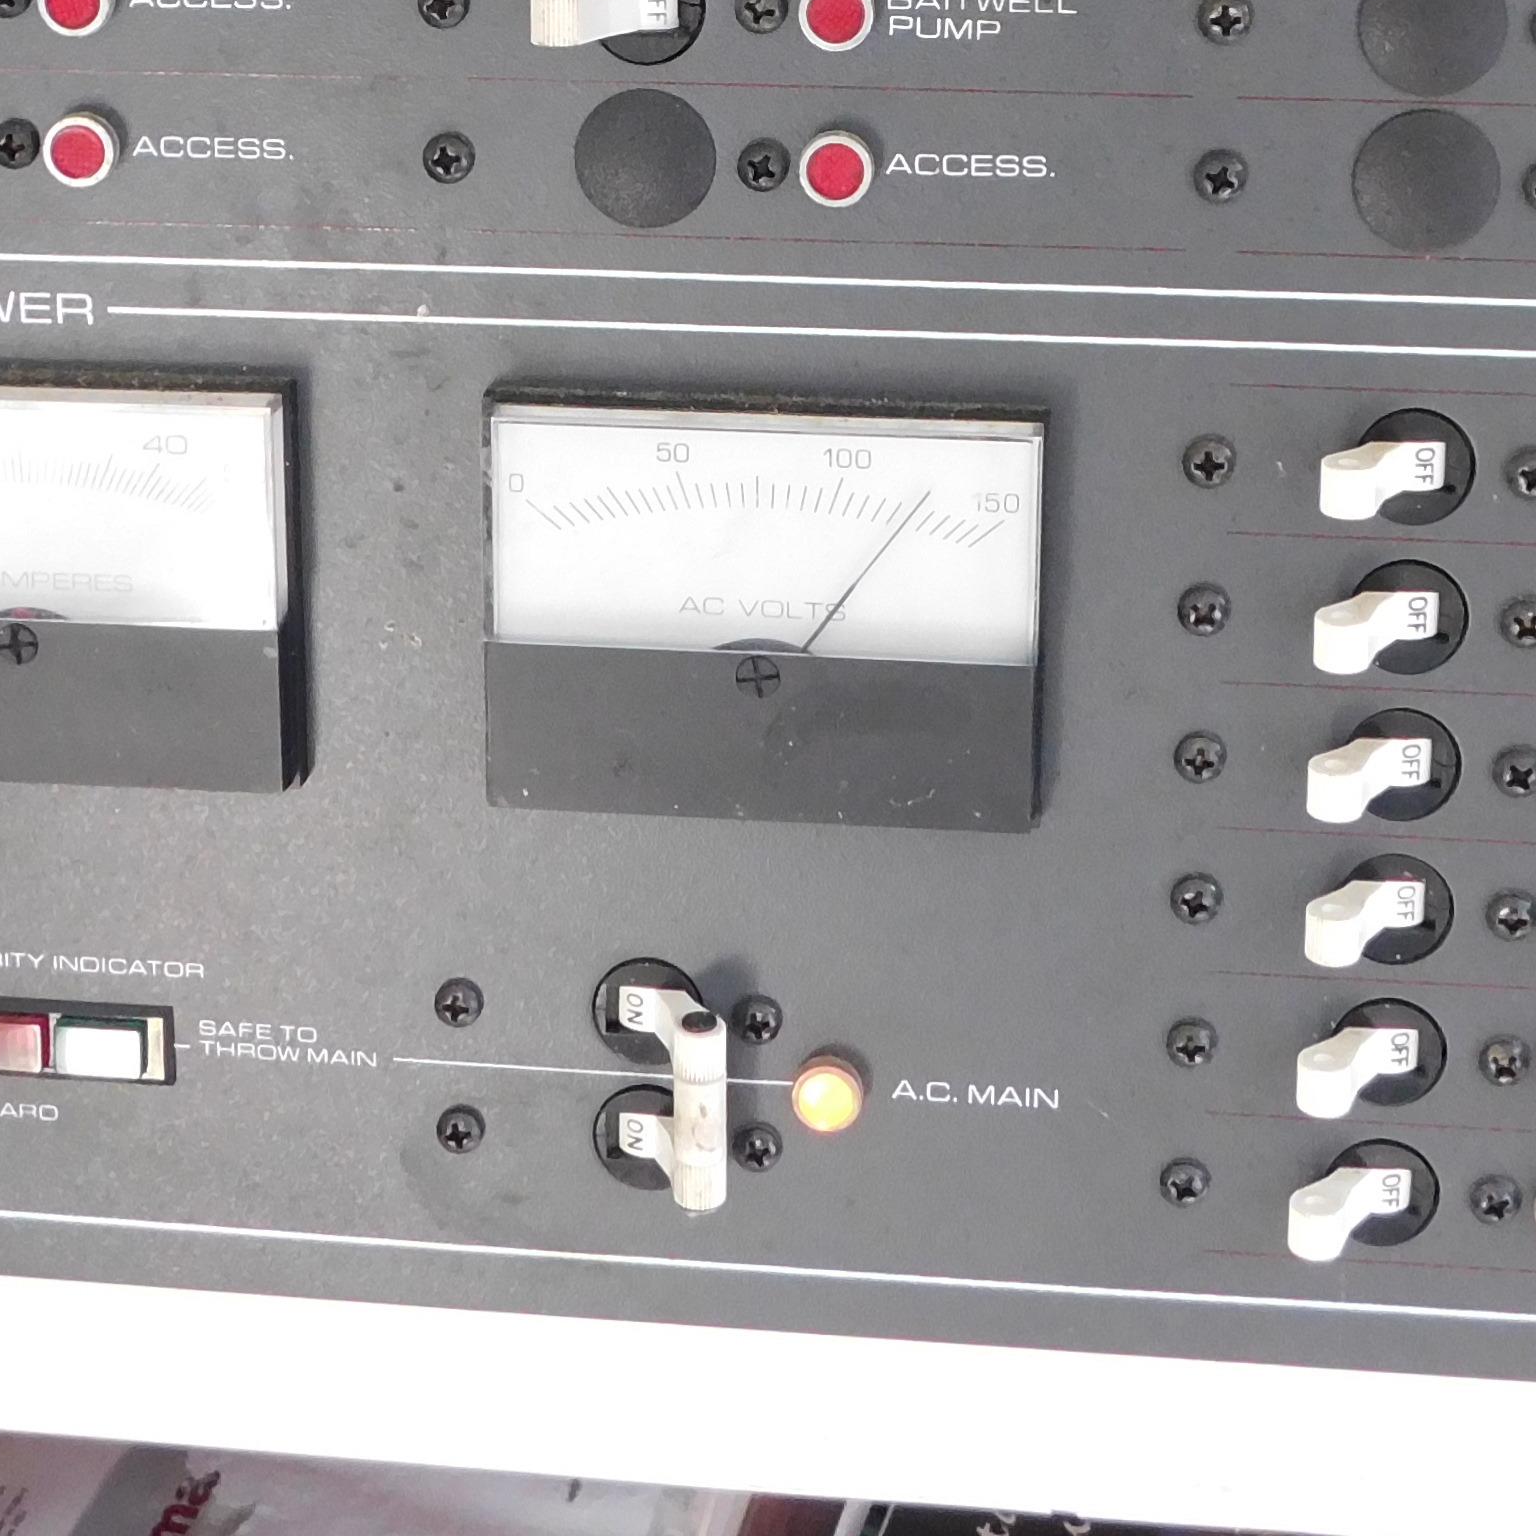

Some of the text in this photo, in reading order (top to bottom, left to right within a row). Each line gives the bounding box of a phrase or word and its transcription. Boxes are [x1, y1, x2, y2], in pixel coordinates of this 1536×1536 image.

[888, 15, 1001, 41] PUMP
[132, 135, 294, 160] ACCESS.
[885, 153, 1055, 178] ACCESS.
[142, 434, 189, 456] 40
[656, 441, 690, 464] 50
[823, 447, 872, 470] 100
[1414, 447, 1436, 485] OFF
[678, 596, 846, 621] AC VOLTS
[1407, 596, 1429, 633] OFF
[1401, 743, 1422, 781] OFF
[1396, 885, 1417, 921] OFF
[52, 955, 205, 979] INDICATOR
[626, 993, 644, 1025] ON
[196, 1018, 318, 1044] SAFE TO
[197, 1039, 378, 1067] THROW MAIN
[1391, 1032, 1410, 1073] OFF
[891, 1079, 1059, 1109] A.C. MAIN
[626, 1119, 644, 1151] ON
[1381, 1173, 1402, 1213] OFF
